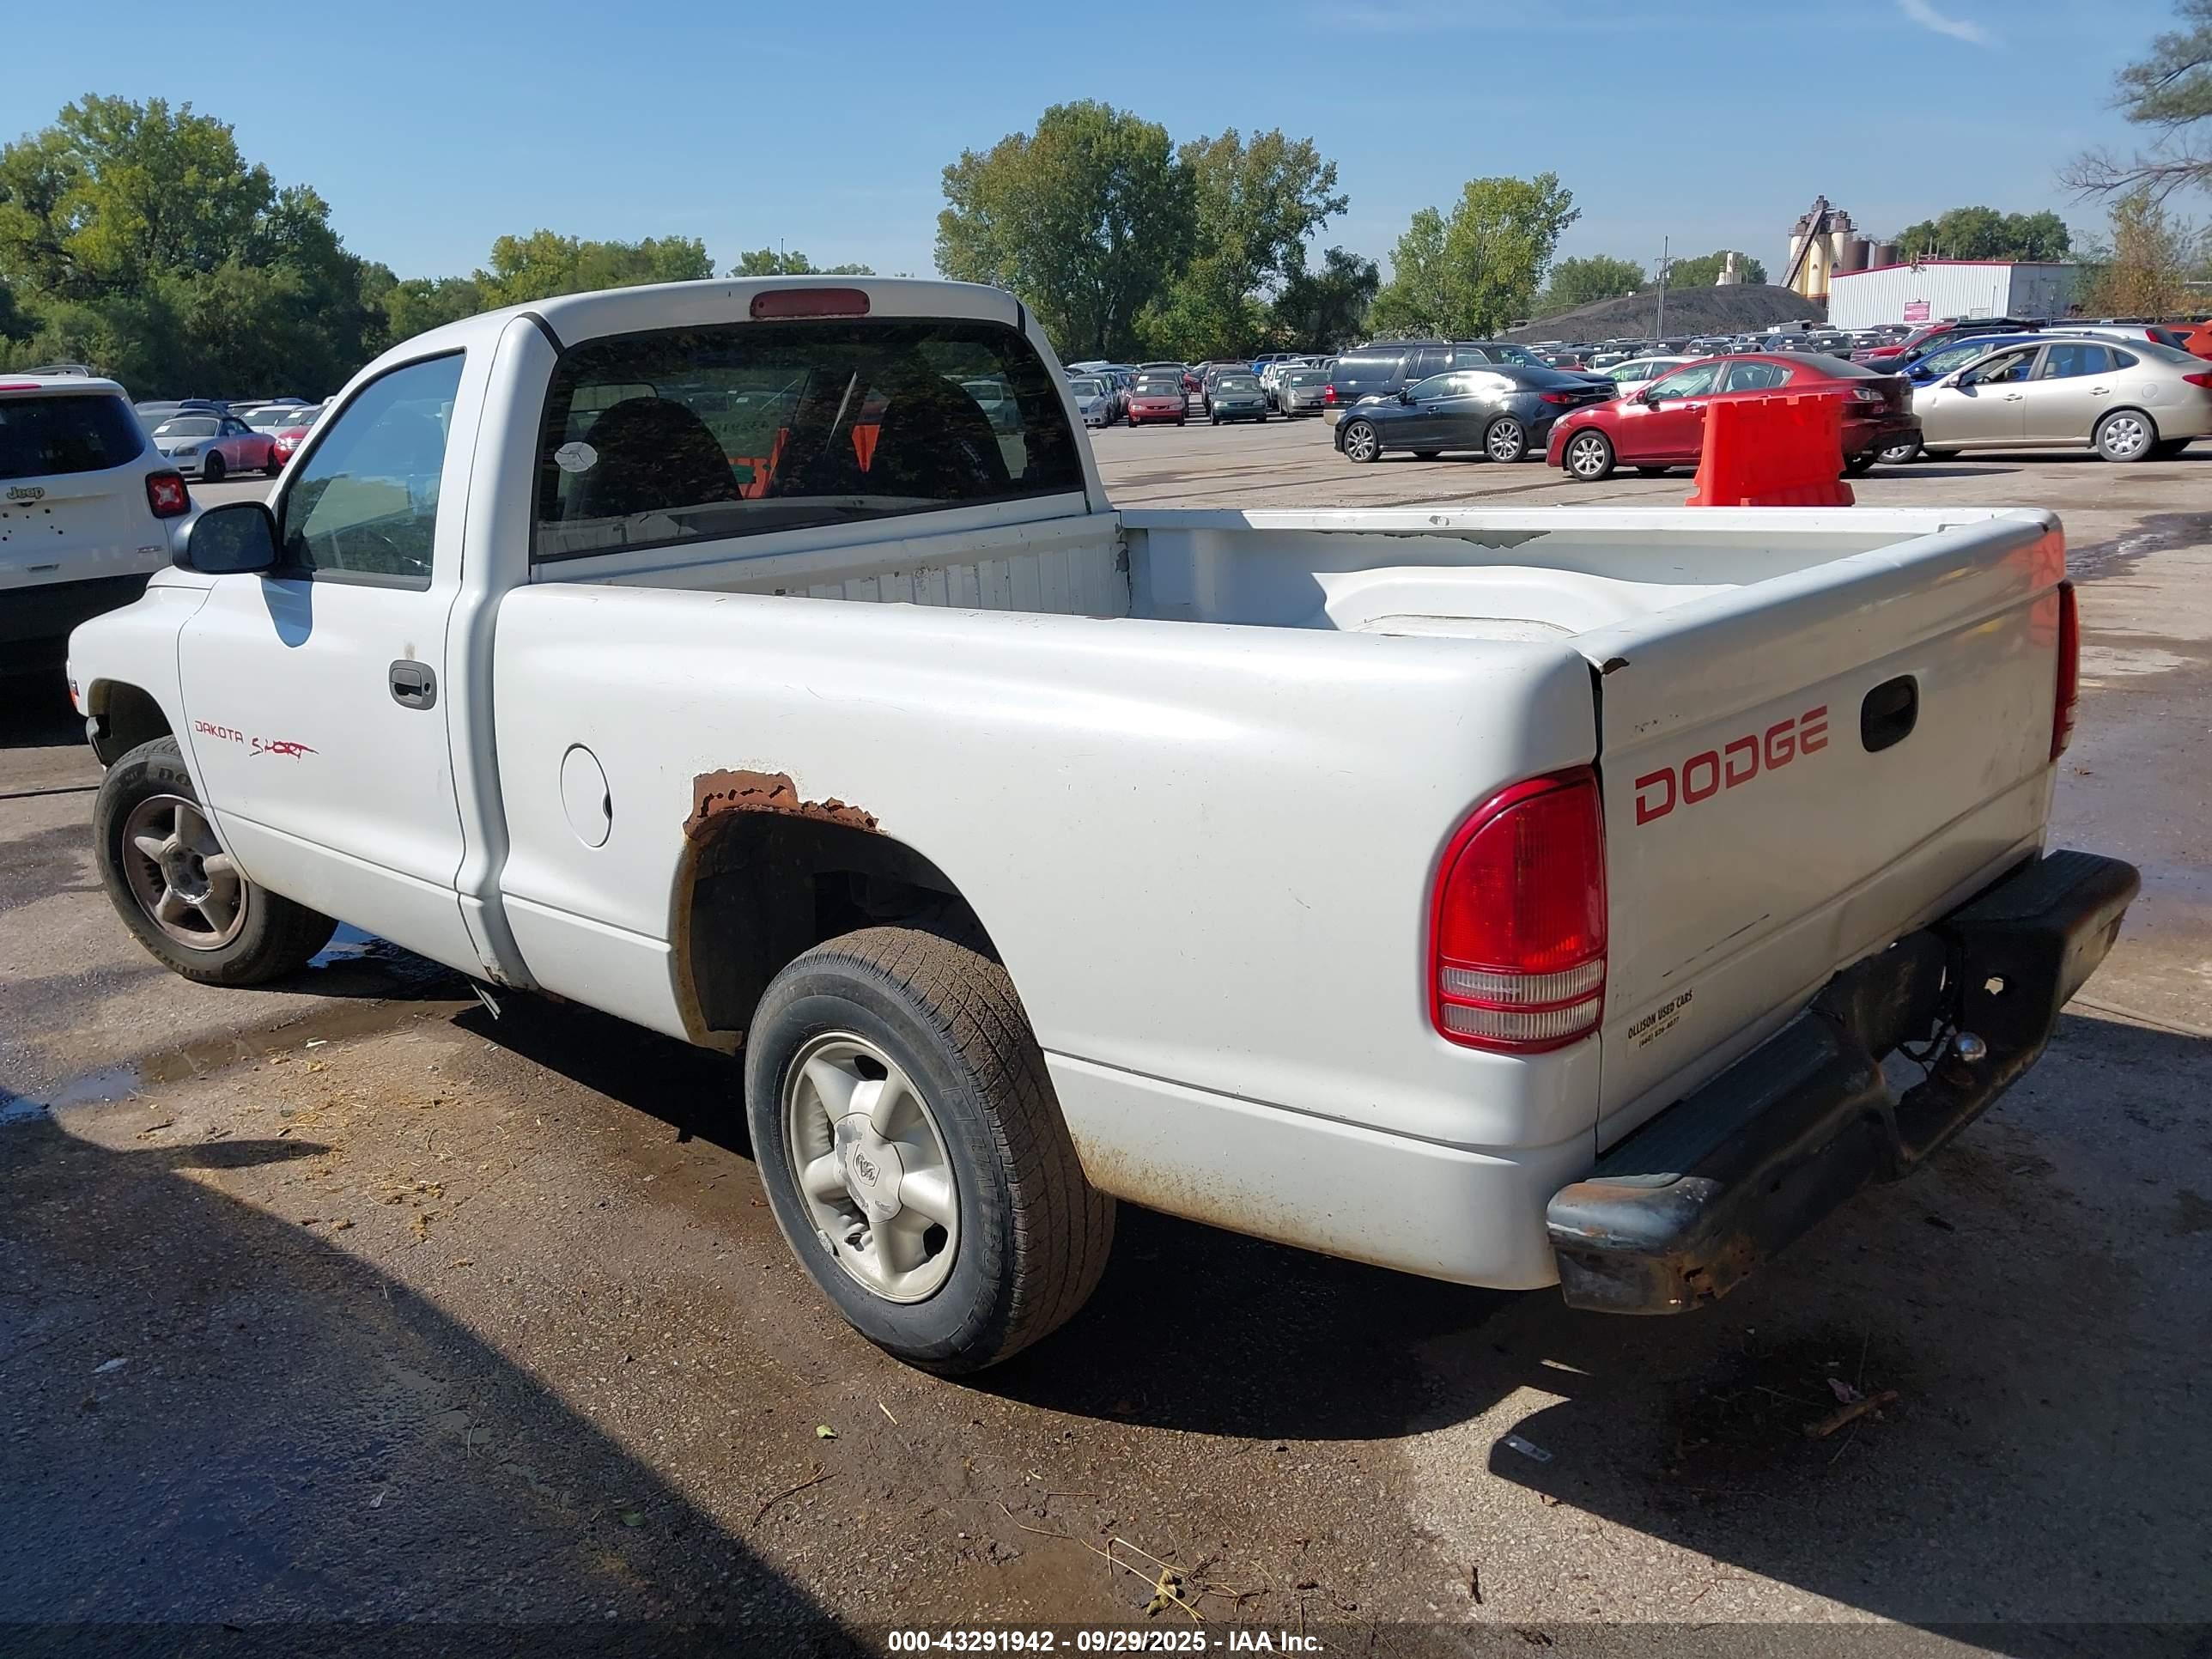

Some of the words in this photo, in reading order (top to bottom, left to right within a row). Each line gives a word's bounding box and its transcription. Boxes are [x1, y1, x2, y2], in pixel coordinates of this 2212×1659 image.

[7, 486, 45, 500] Jeep
[194, 720, 245, 744] DAKOTA
[1635, 705, 1828, 825] DODGE
[1628, 1013, 1656, 1040] OLLISON
[1657, 1001, 1675, 1021] USED
[1676, 987, 1693, 1008] CARS
